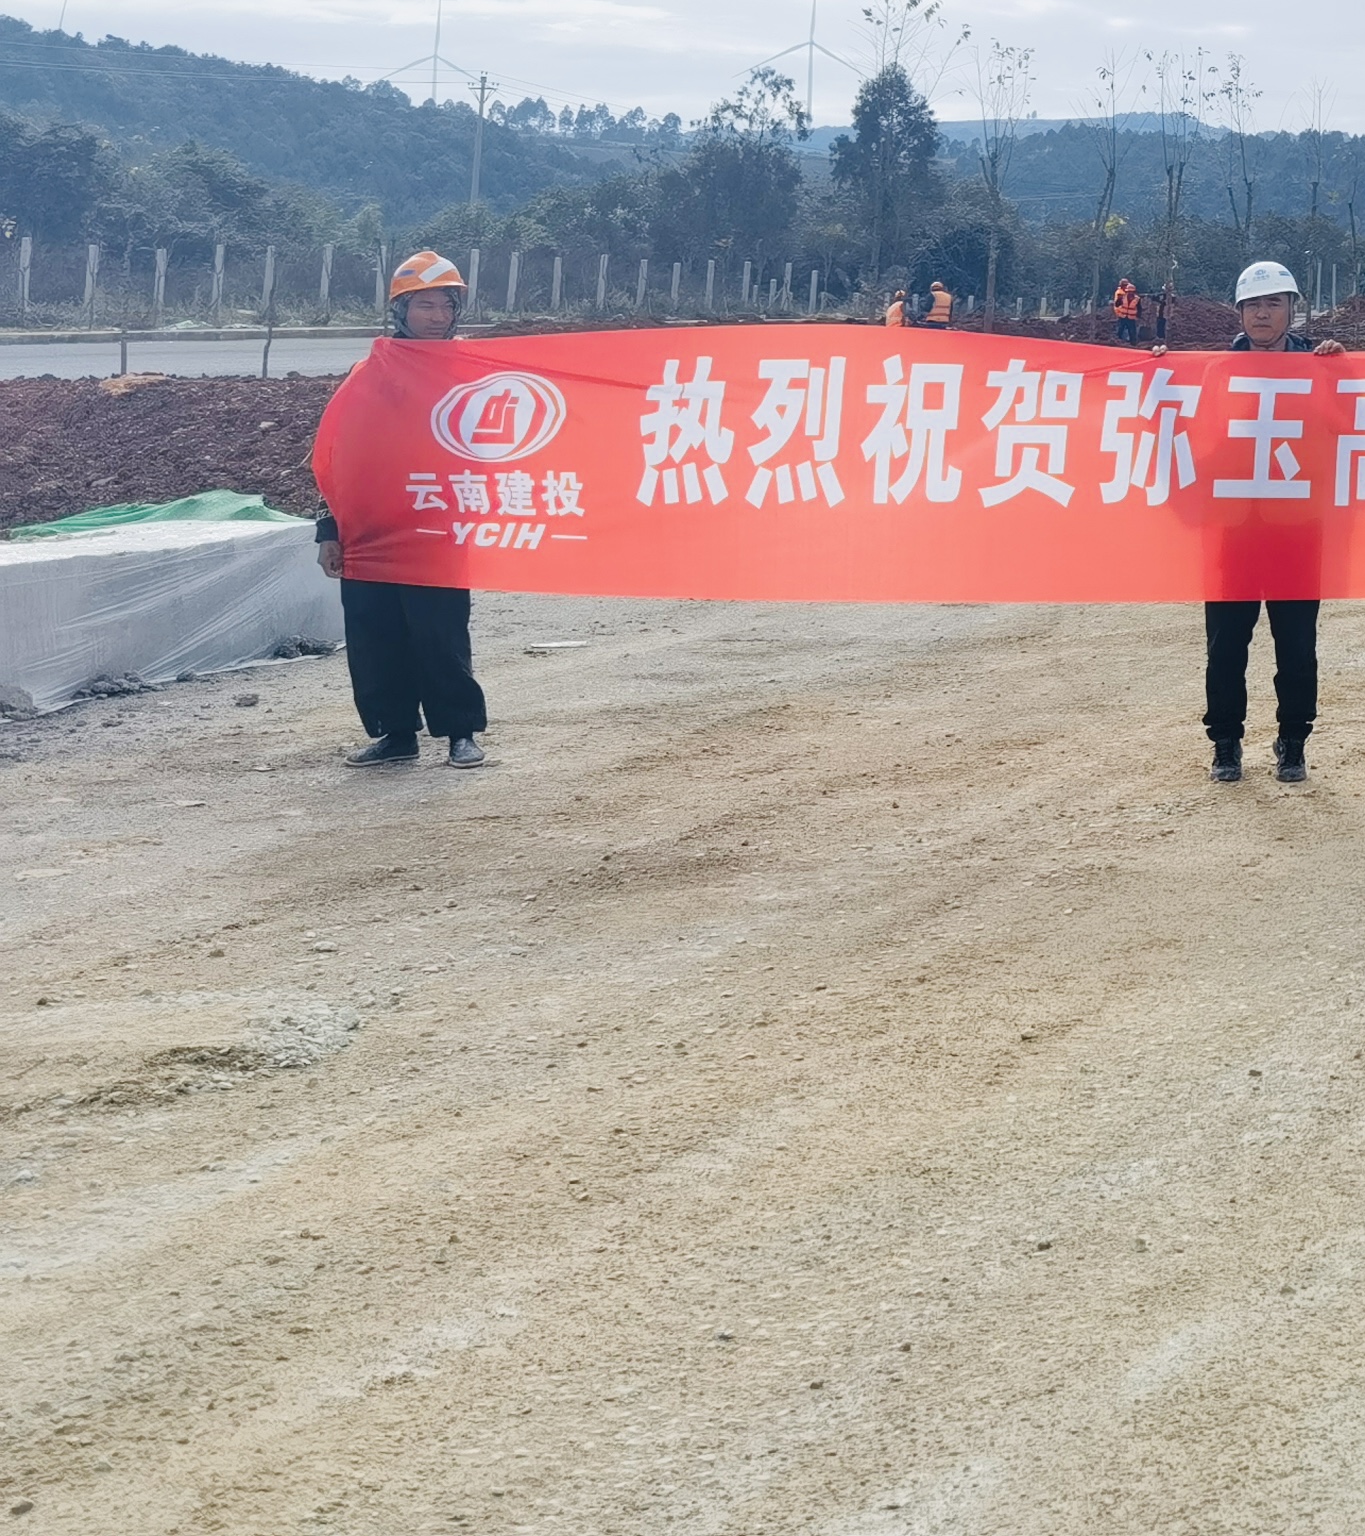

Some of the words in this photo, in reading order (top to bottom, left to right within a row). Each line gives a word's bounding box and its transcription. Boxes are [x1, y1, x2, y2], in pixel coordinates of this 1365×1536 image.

[405, 469, 586, 518] 云南建投
[452, 521, 547, 551] YCIH
